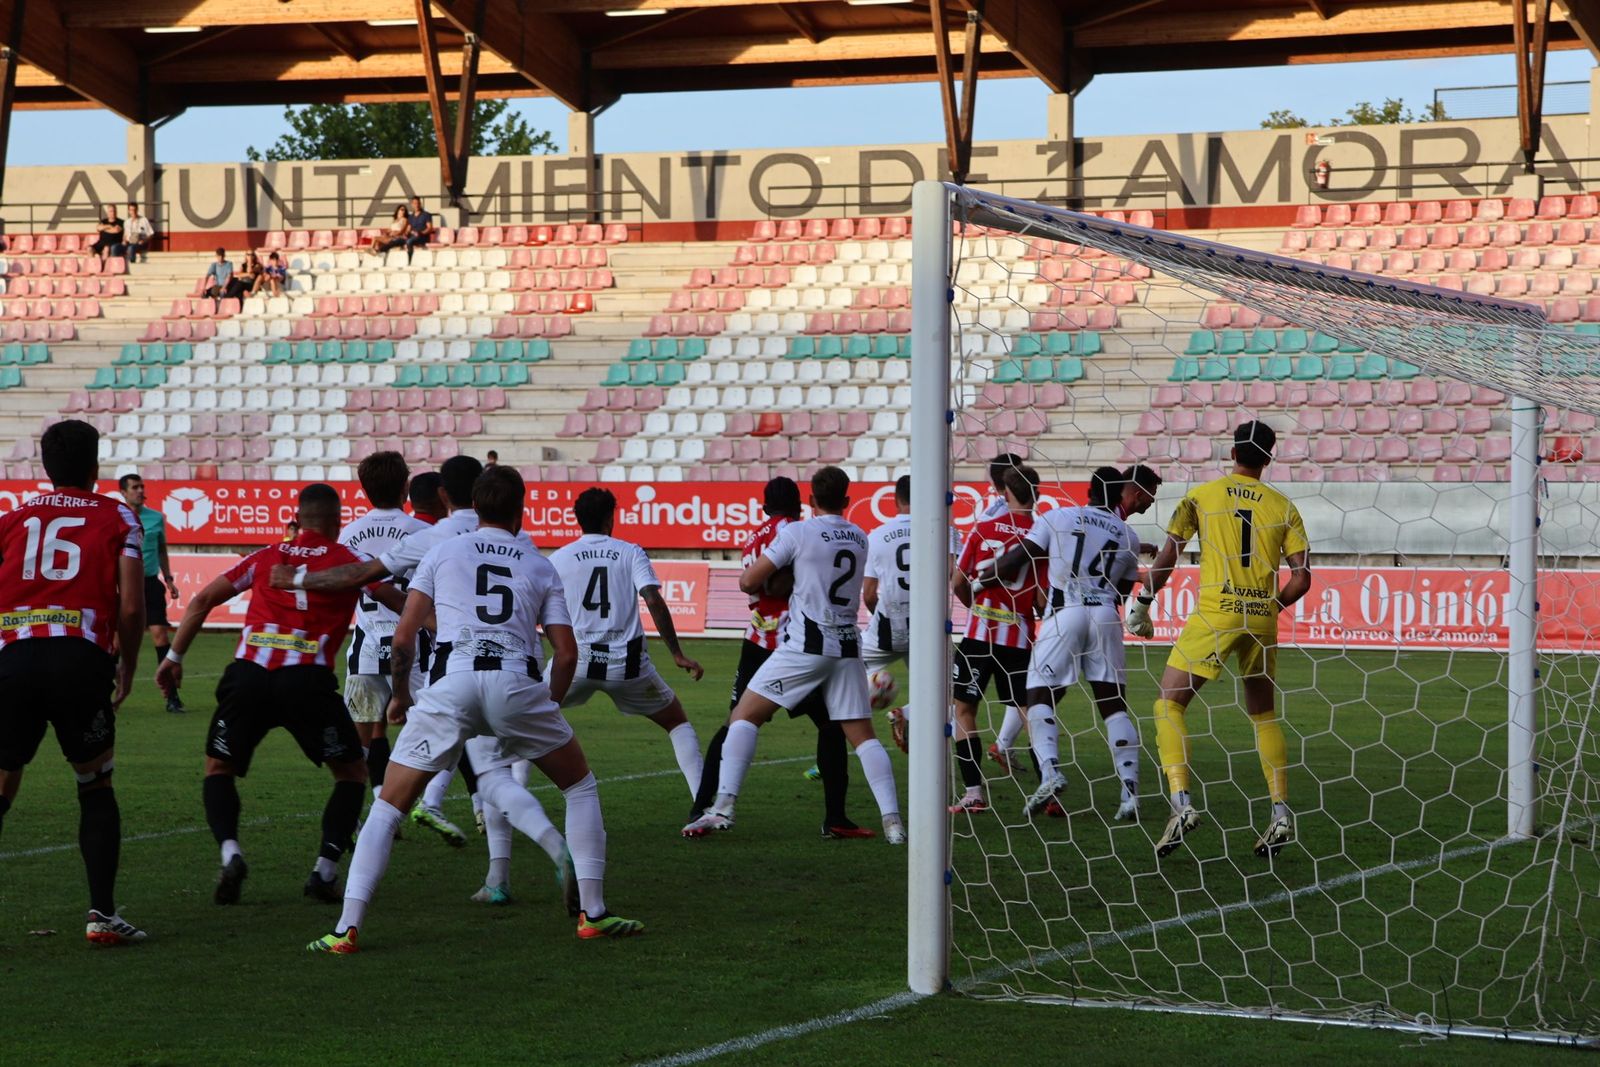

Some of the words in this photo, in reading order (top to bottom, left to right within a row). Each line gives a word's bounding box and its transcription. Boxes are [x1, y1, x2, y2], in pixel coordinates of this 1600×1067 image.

[46, 152, 823, 231] AYUNTAMIENTO
[1035, 122, 1586, 212] ZAMORA
[216, 488, 366, 499] ORTOPIA
[214, 502, 270, 523] tres
[619, 503, 639, 525] la
[349, 526, 385, 550] MANU
[702, 526, 730, 542] de
[1234, 509, 1253, 568] 1
[22, 516, 86, 581] 16
[474, 543, 525, 560] VADIK
[574, 549, 621, 562] TRILLES
[1069, 529, 1119, 589] 14
[828, 549, 857, 606] 2
[475, 563, 514, 625] 5
[582, 566, 611, 619] 4
[2, 612, 79, 629] Rapimueble
[1309, 626, 1326, 639] El
[1334, 626, 1390, 640] Correo
[1405, 627, 1431, 640] de
[1431, 628, 1498, 643] Zamora
